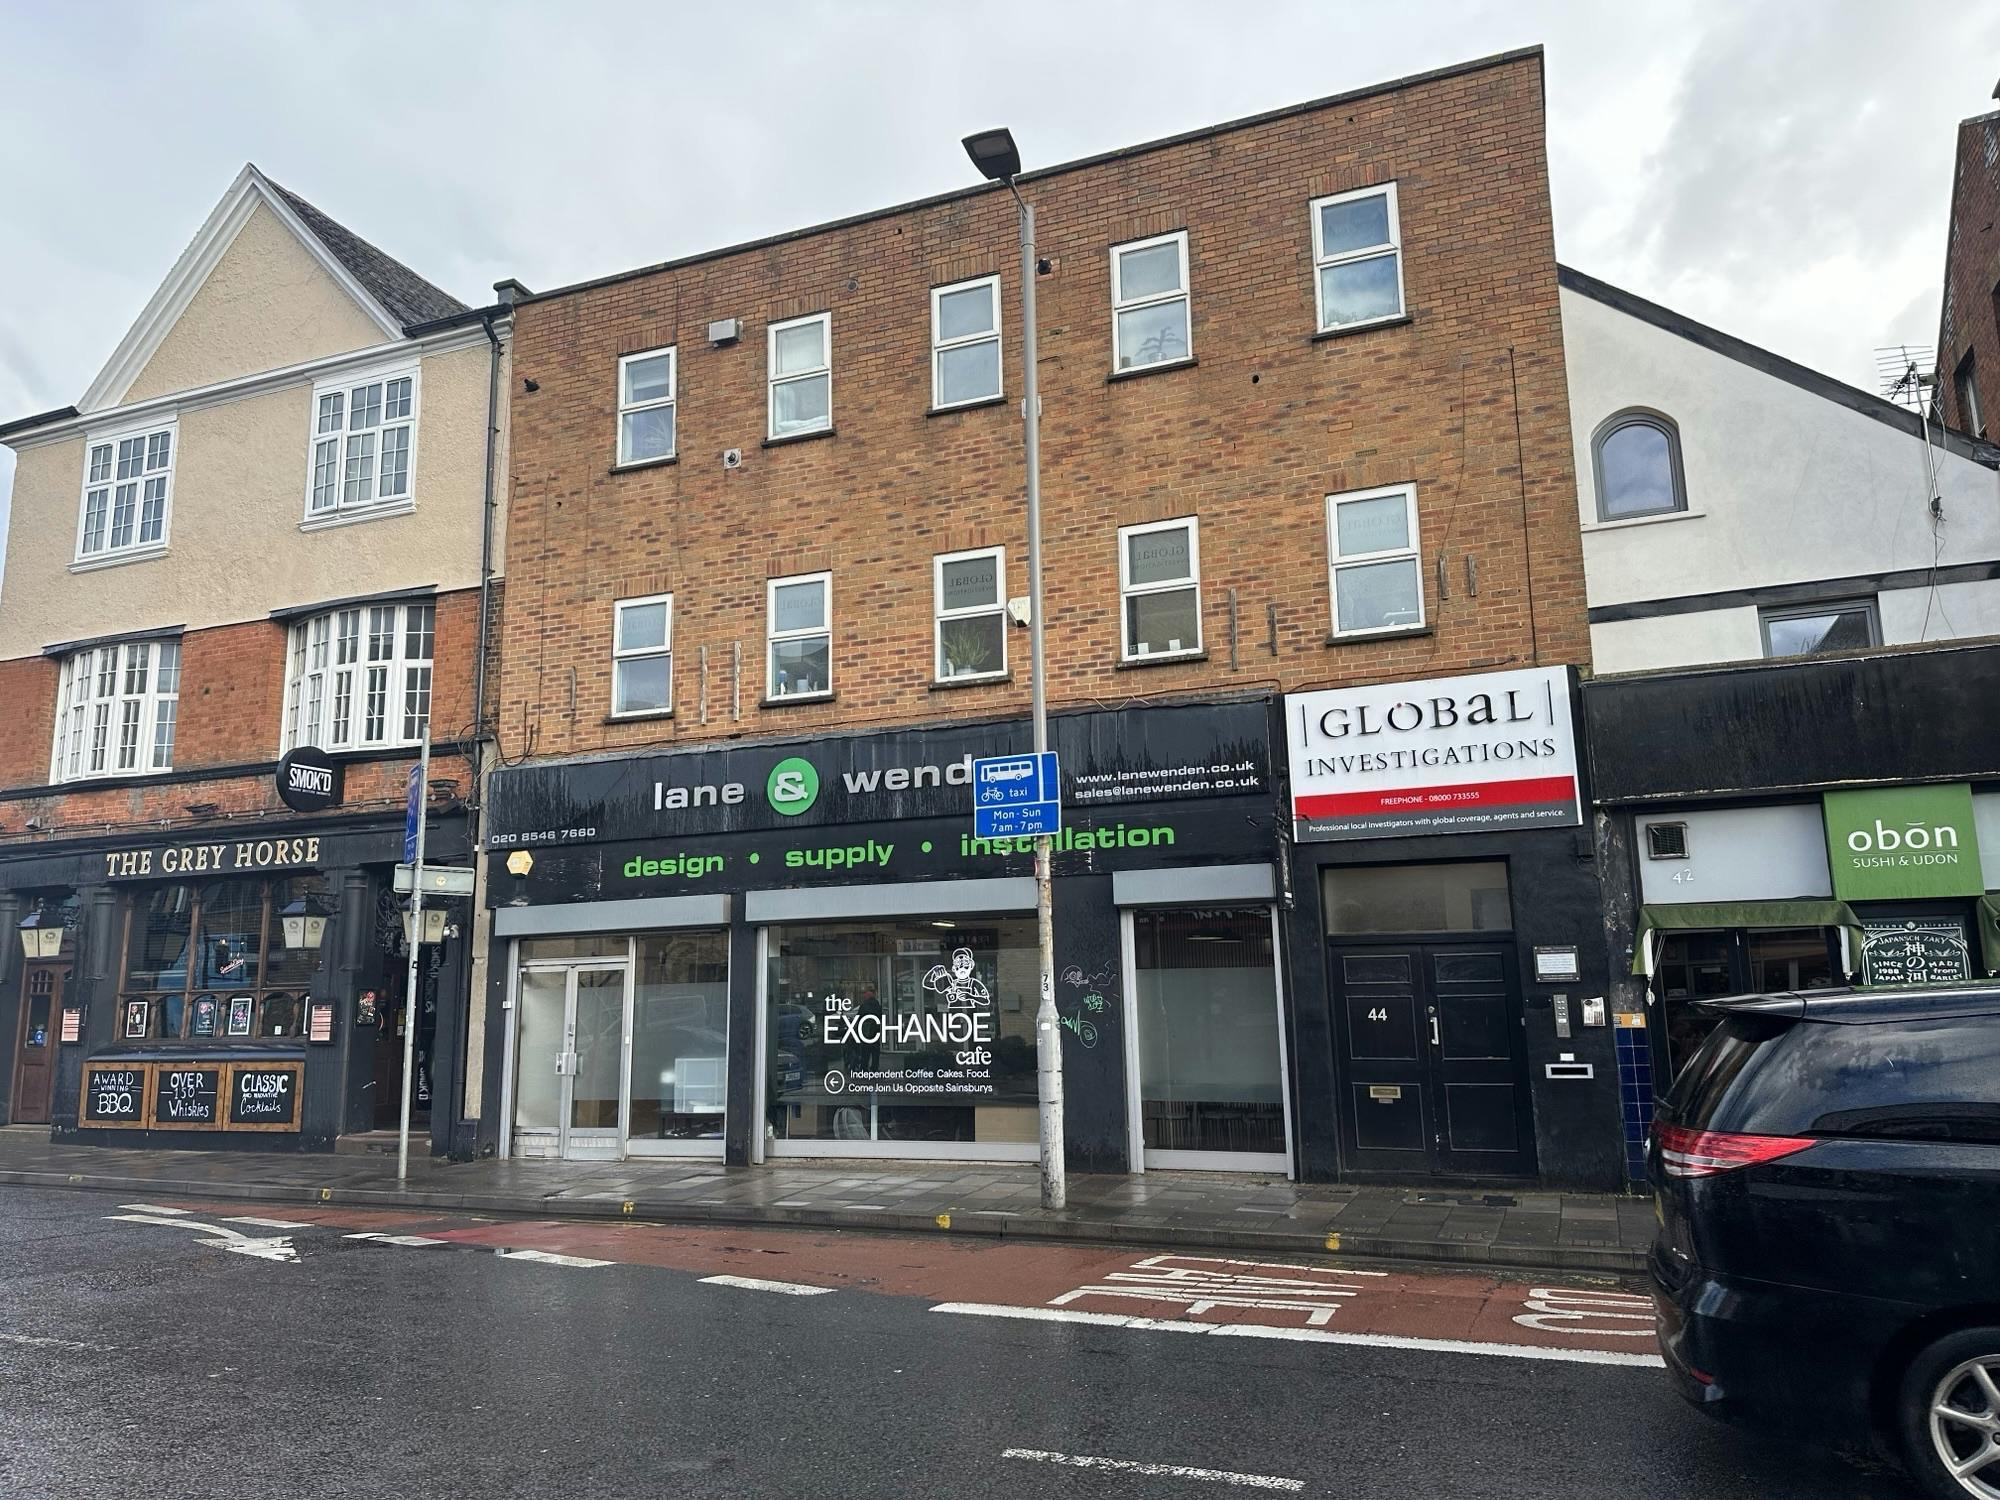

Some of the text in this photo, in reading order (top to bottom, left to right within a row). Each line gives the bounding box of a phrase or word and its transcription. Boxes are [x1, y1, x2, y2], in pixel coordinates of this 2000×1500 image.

[1307, 738, 1556, 777] INVESTIGATIONS
[289, 767, 332, 792] SMOK'D
[1076, 760, 1255, 784] www.lanewenden.co.uk
[654, 753, 972, 811] lane & wend
[1075, 775, 1260, 799] sales@lanewenden.co.uk
[1009, 786, 1028, 798] taxi
[1380, 795, 1424, 806] FREEPHONE
[1429, 793, 1452, 802] 08000
[1453, 791, 1480, 800] 733555
[993, 809, 1015, 820] Mon
[1022, 808, 1041, 817] Sun
[1309, 822, 1350, 833] Professional
[1351, 821, 1367, 830] local
[1415, 817, 1431, 825] with
[1432, 815, 1456, 826] global
[1457, 814, 1493, 823] coverage,
[1494, 812, 1519, 822] agents
[1520, 810, 1535, 818] and
[1536, 809, 1566, 818] service.
[491, 827, 596, 844] 020 8546 7660
[107, 837, 320, 877] THE GREY HORSE
[624, 853, 724, 878] design
[785, 839, 895, 869] supply
[1853, 854, 1958, 868] SUSHI & UDON
[1672, 868, 1694, 884] 42
[1873, 960, 1904, 969] SINCE
[1929, 960, 1960, 968] MADE
[1875, 973, 1905, 981] JAPAN
[1930, 972, 1963, 981] BARLEY
[825, 993, 852, 1012] the
[1367, 1008, 1387, 1022] 44
[823, 1012, 992, 1044] EXCHANGE
[955, 1046, 992, 1066] cafe
[93, 1071, 134, 1086] AWARD
[170, 1072, 204, 1089] OVER
[850, 1068, 991, 1080] Independent Coffee Cakes. Food.
[100, 1084, 130, 1092] WINNING
[241, 1073, 289, 1094] CLASSIC
[848, 1082, 993, 1094] Come Join Us Opposite Sainsburys
[174, 1087, 196, 1100] 150
[96, 1092, 134, 1114] BBQ
[168, 1099, 209, 1118] Whiskies
[240, 1098, 282, 1116] Cocktails
